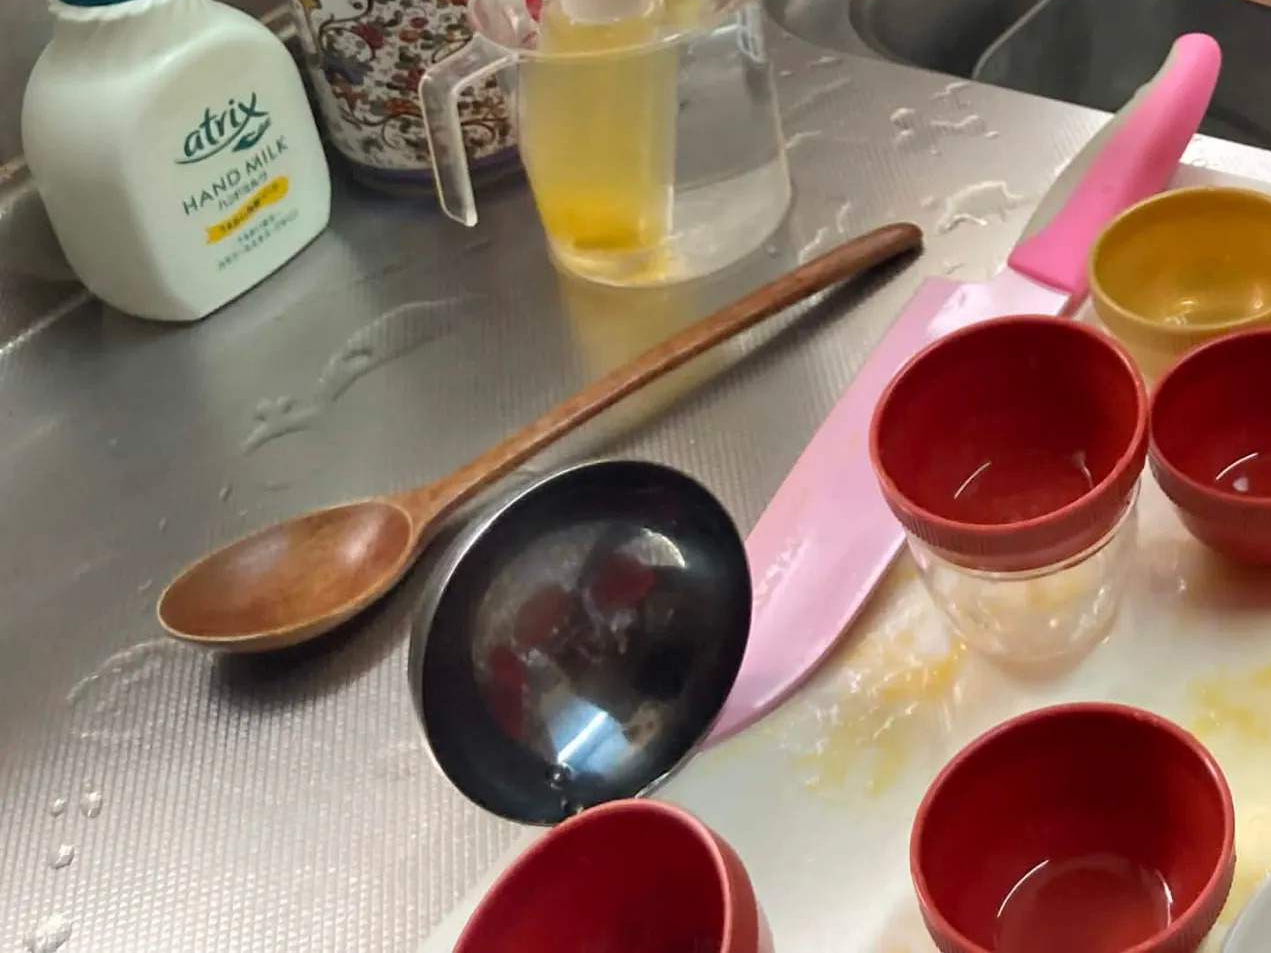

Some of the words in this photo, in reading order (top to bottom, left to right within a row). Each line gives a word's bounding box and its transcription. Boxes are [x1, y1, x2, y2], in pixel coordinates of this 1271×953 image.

[175, 91, 270, 165] atrix
[182, 168, 242, 217] HAND
[245, 134, 289, 177] MILK
